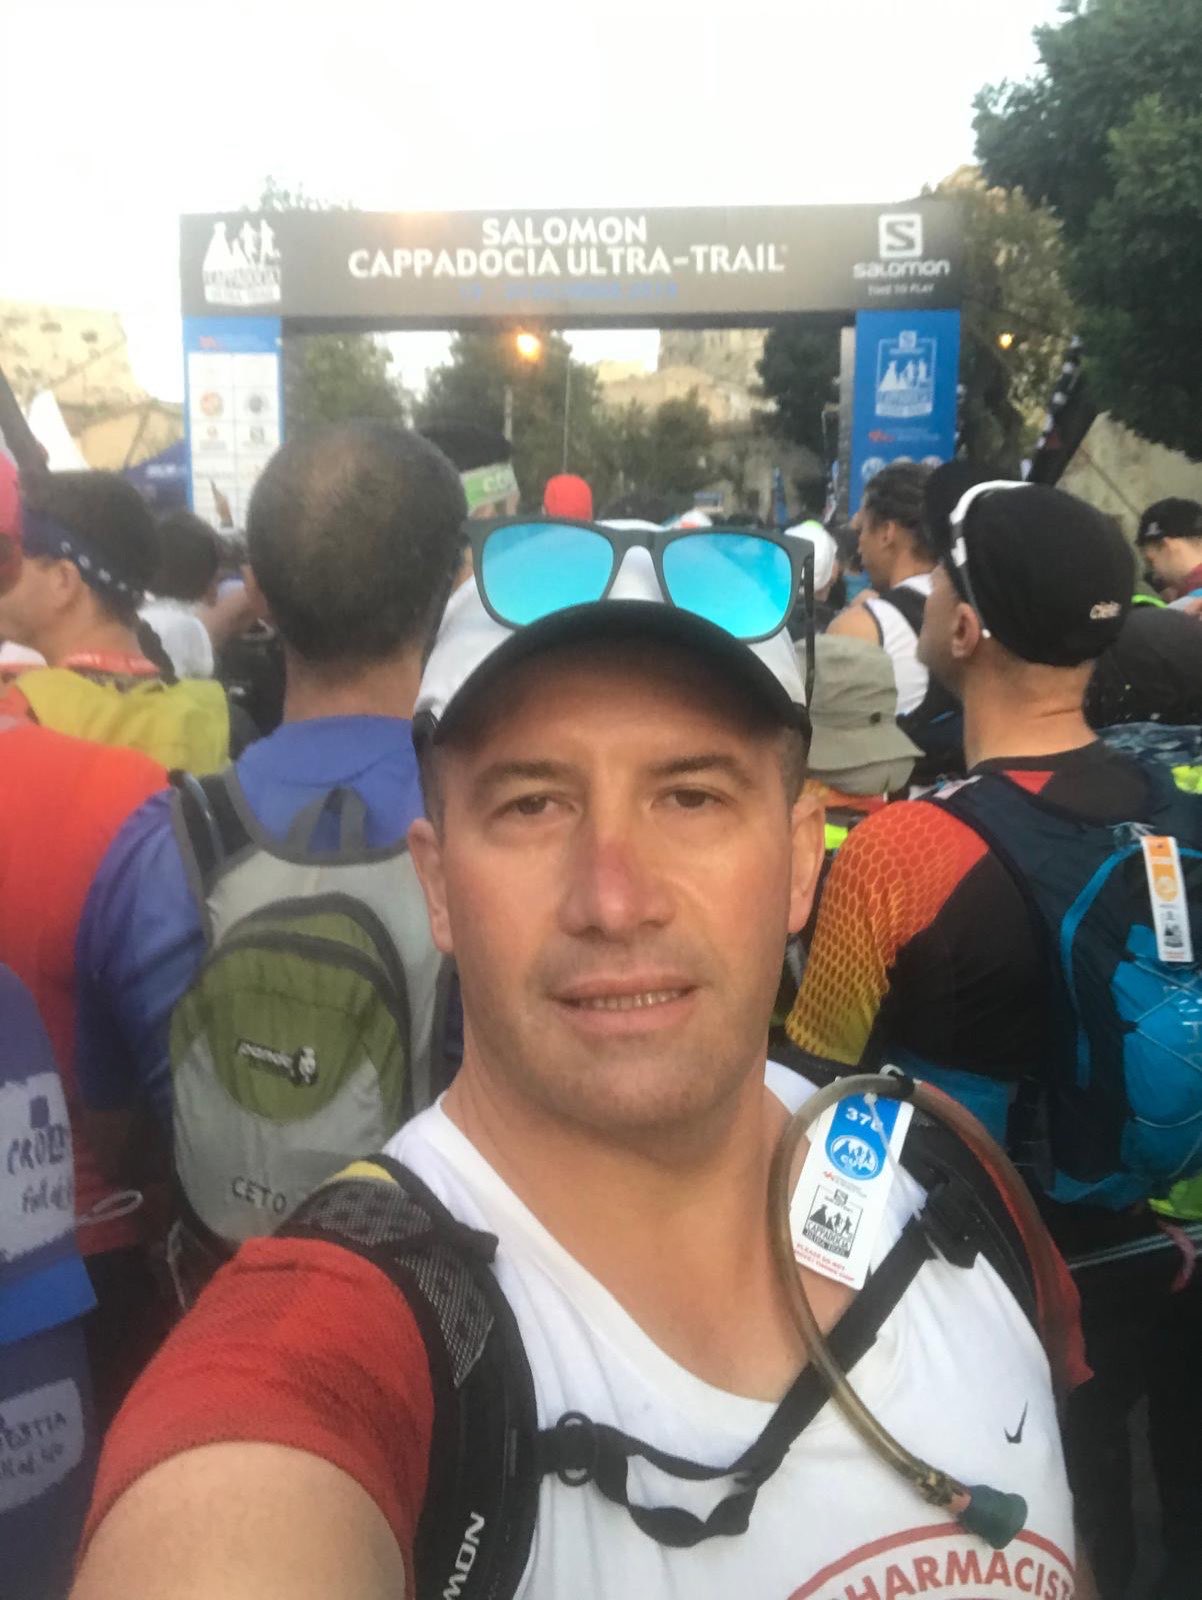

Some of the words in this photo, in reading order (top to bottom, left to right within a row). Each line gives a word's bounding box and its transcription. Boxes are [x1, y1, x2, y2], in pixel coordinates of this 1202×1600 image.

[481, 215, 648, 247] SALOMON
[348, 247, 562, 279] CAPPADOCIA
[566, 243, 786, 277] ULTRA-TRAIL
[231, 1175, 289, 1214] CETO
[832, 1549, 1072, 1600] HARMACIST
